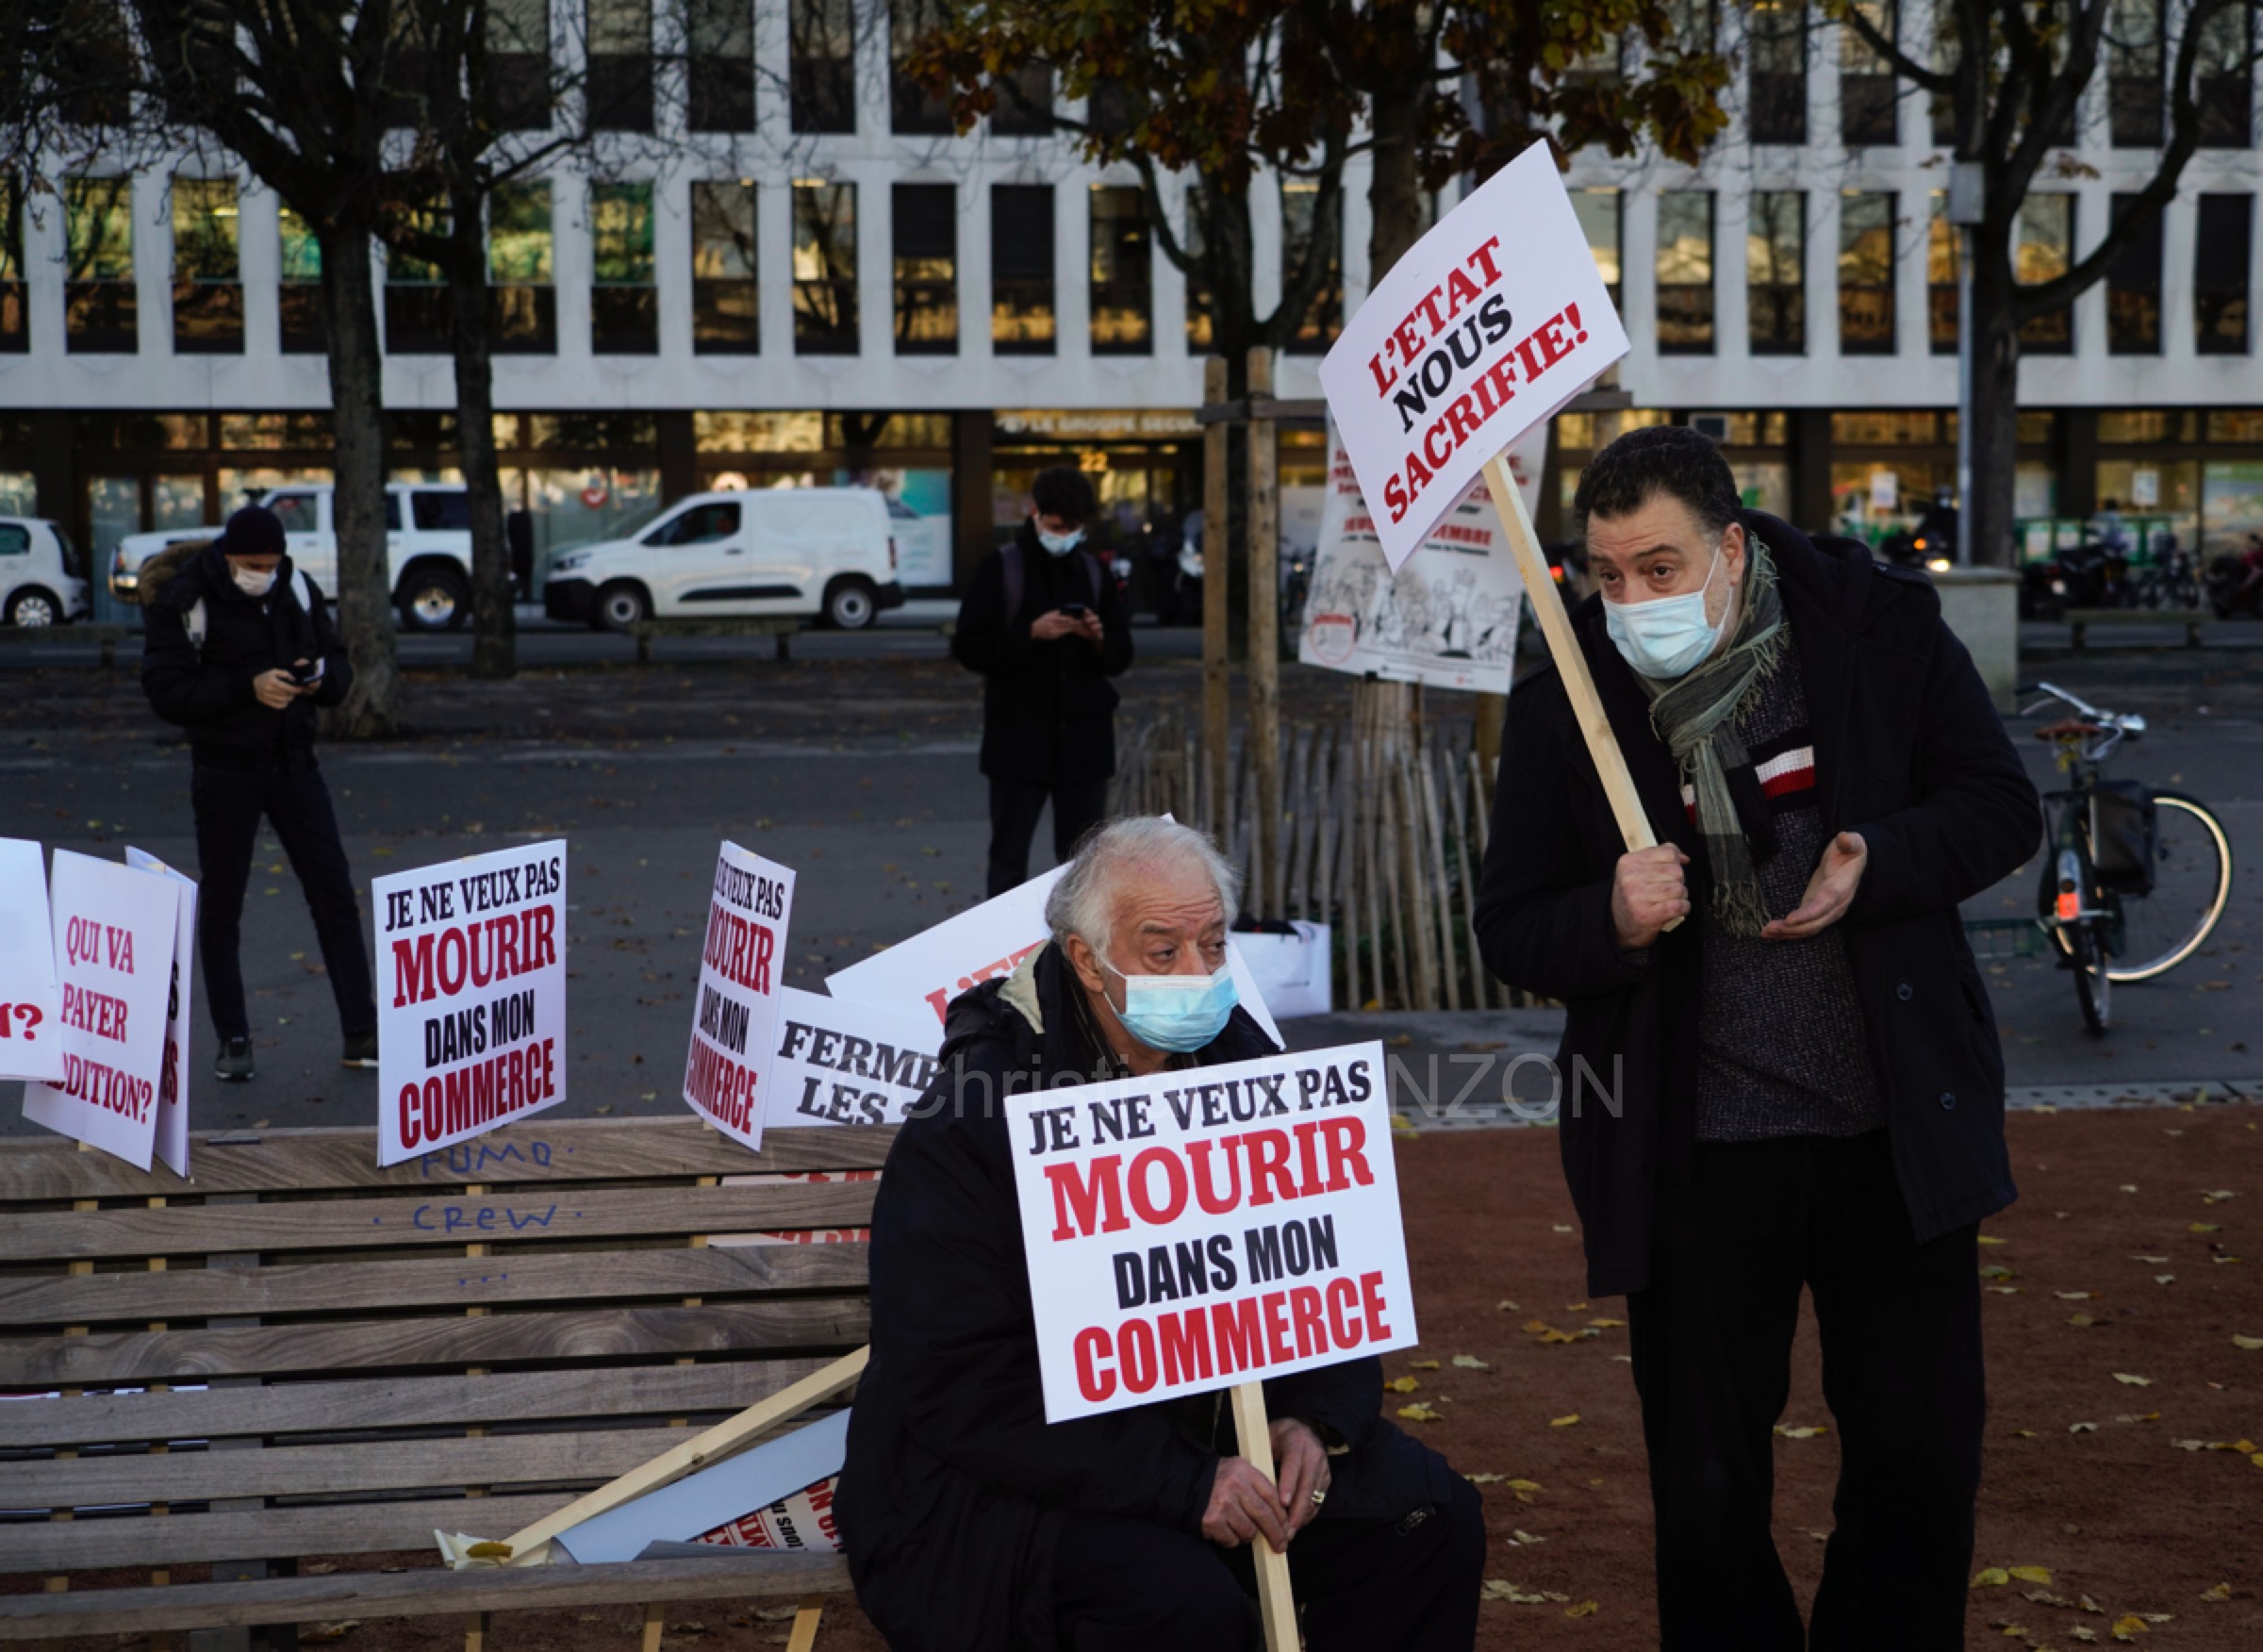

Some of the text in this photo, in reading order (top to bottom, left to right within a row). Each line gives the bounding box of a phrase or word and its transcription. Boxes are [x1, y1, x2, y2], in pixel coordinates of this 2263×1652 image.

[1367, 236, 1503, 399] L'ETAT
[1392, 293, 1512, 434] NOUS
[1383, 303, 1589, 524] SACRIFIE!
[385, 855, 561, 932] JE NE VEUX PAS
[755, 876, 785, 920] PAS
[66, 915, 134, 975] QUI VA
[391, 903, 557, 1009] MOURIR
[60, 982, 128, 1043] PAYER
[424, 988, 534, 1068] DANS MON
[719, 996, 750, 1055] MON
[399, 1038, 554, 1149] COMMERCE
[796, 1076, 888, 1124] LES
[1029, 1060, 1371, 1155] JE NE VEUX PAS
[1044, 1115, 1374, 1242] MOURIR
[1113, 1214, 1339, 1309] DANS MON
[1073, 1271, 1393, 1403] COMMERCE
